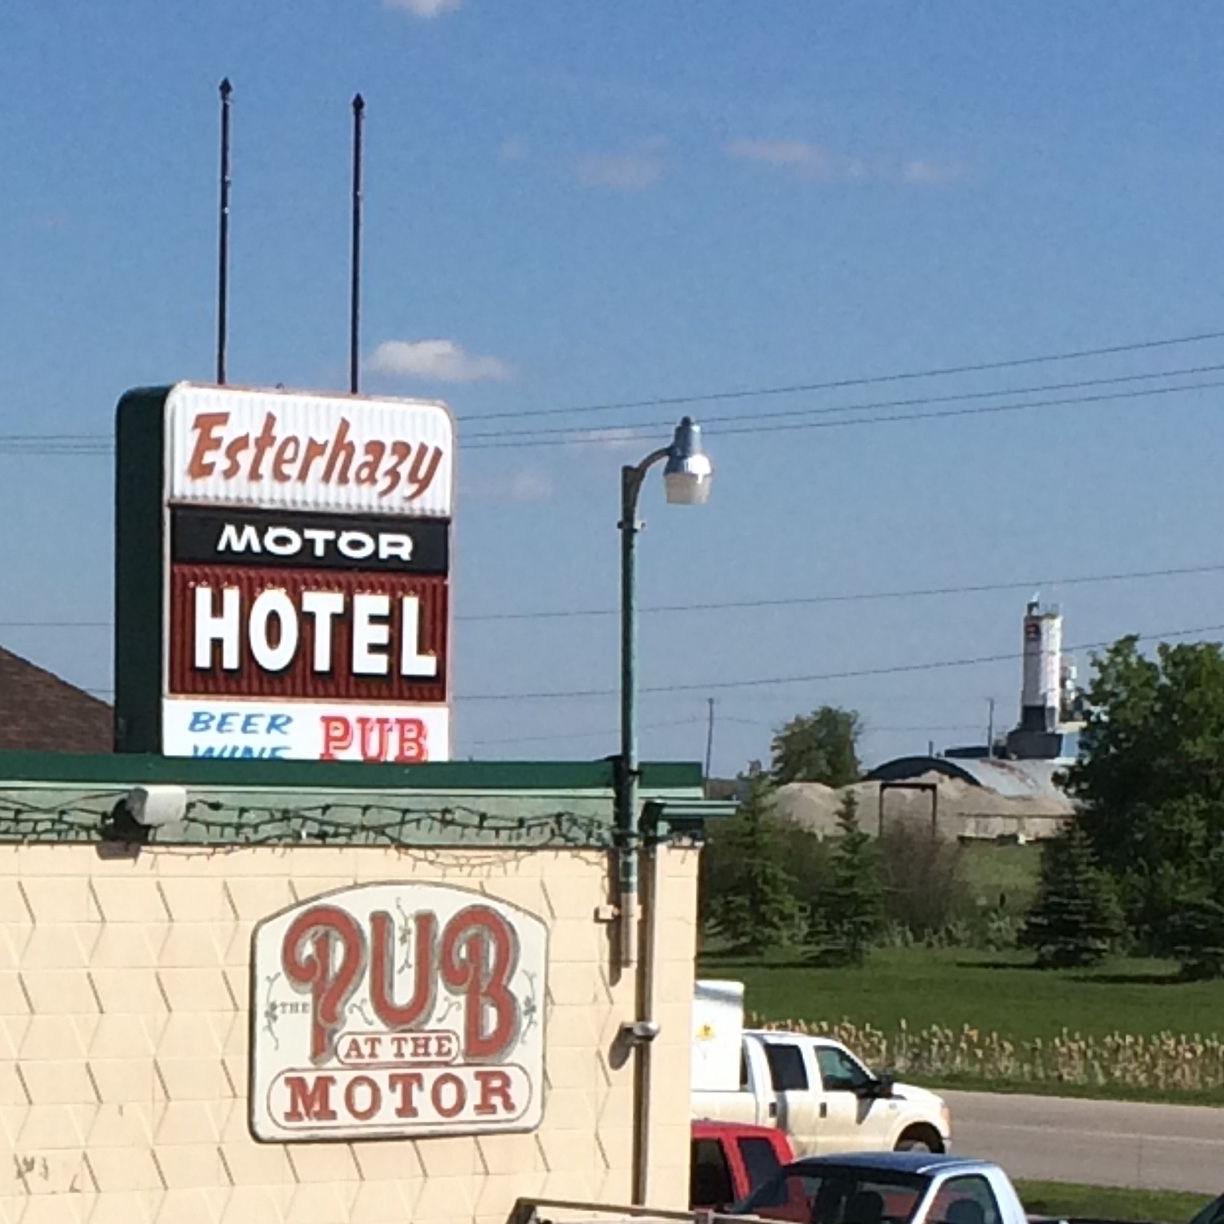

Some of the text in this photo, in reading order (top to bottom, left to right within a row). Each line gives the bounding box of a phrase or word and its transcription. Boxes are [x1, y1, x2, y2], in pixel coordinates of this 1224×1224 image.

[188, 411, 442, 500] Esterhazy
[217, 524, 413, 561] MOTOR
[194, 586, 437, 677] HOTEL
[188, 711, 293, 735] BEER
[319, 715, 429, 762] PUB
[281, 904, 521, 1066] PUB
[343, 1034, 453, 1060] AT THE
[283, 1070, 516, 1122] MOTOR
